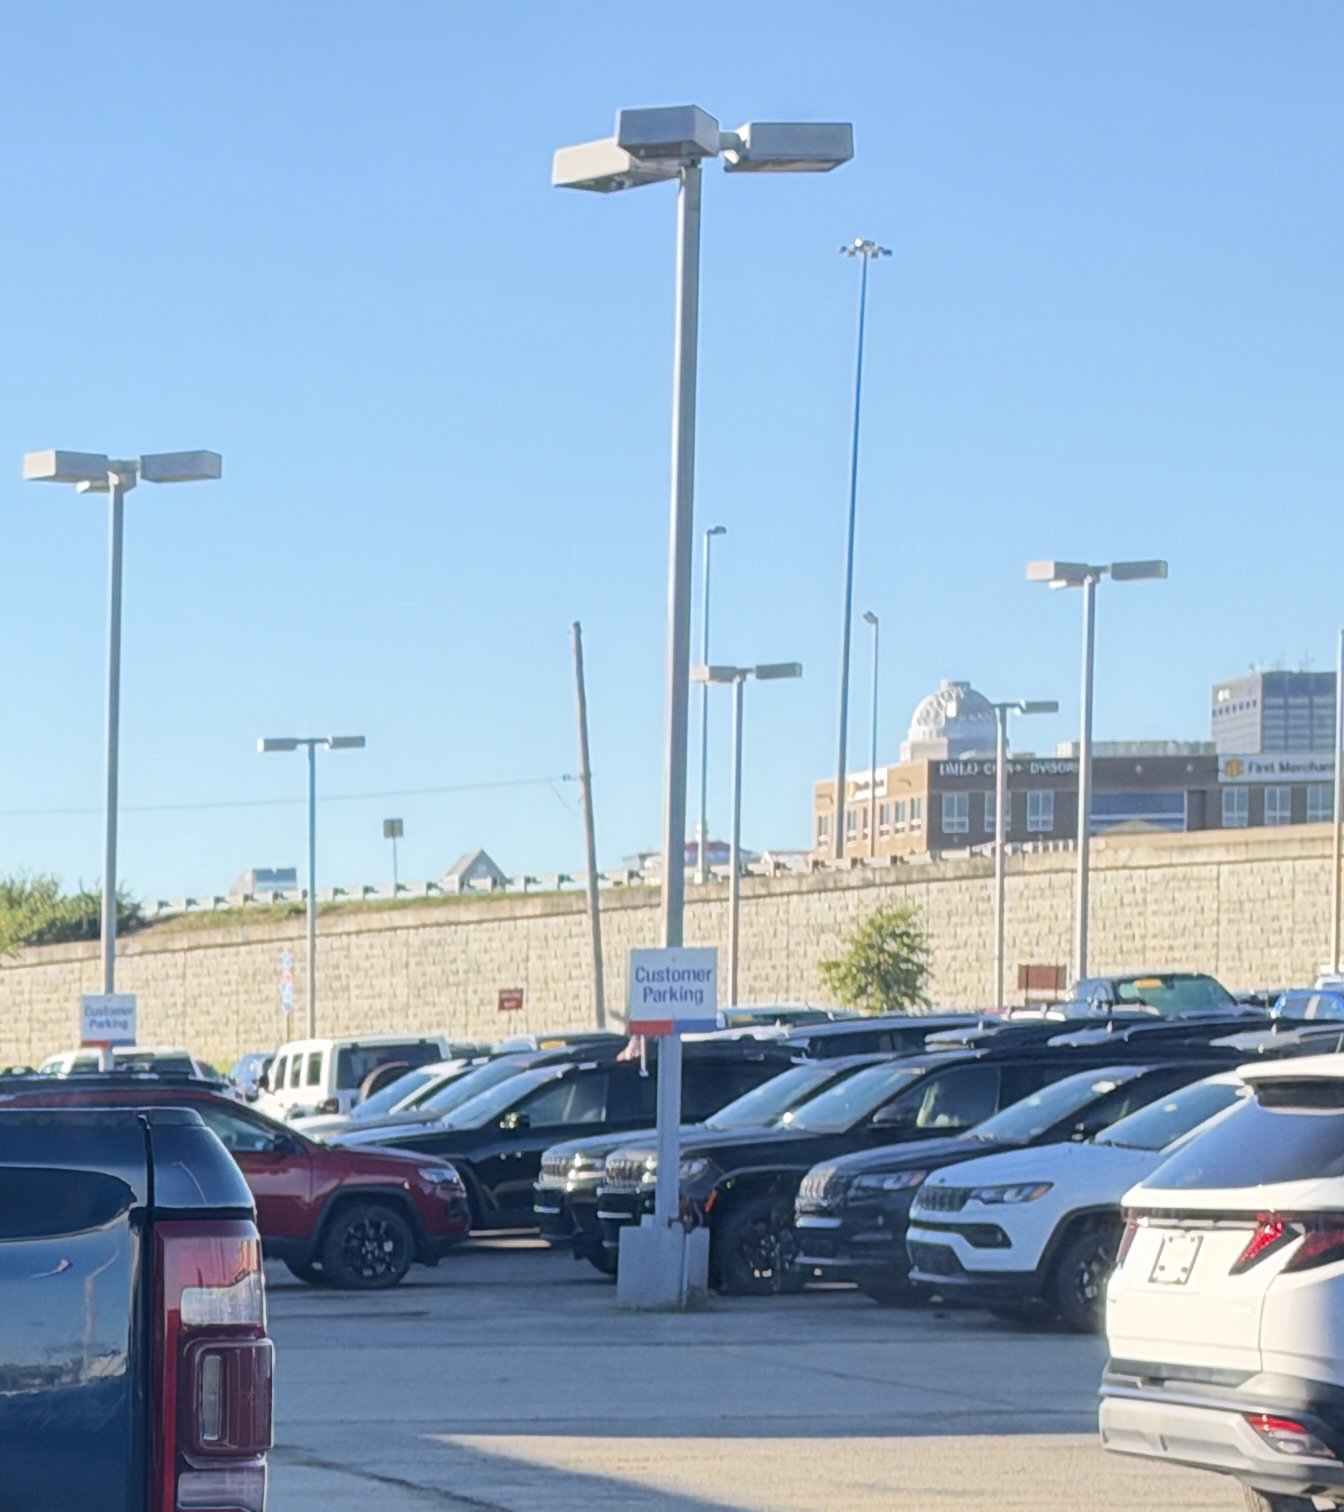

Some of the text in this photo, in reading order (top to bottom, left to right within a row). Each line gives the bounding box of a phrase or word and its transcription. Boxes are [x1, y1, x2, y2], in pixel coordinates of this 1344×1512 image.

[635, 966, 712, 983] Customer
[643, 986, 704, 1006] Parking
[89, 1019, 128, 1031] Parking
